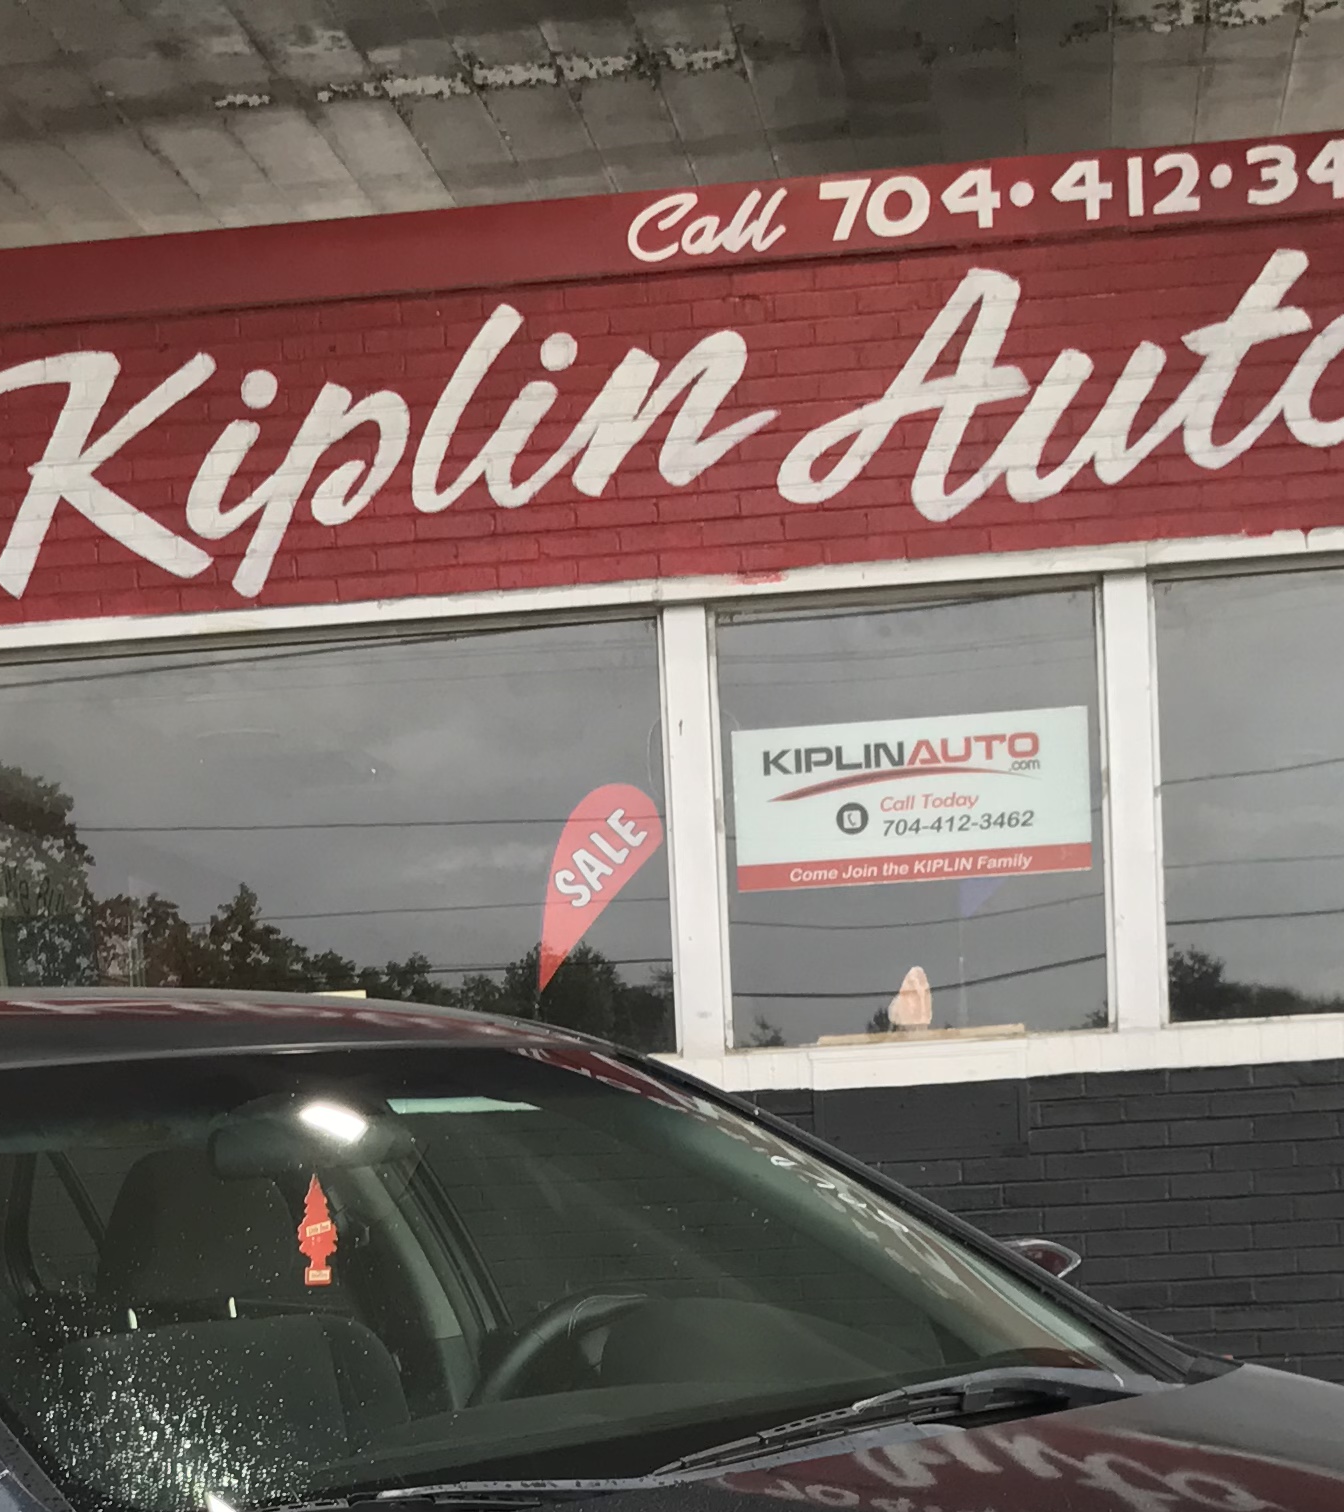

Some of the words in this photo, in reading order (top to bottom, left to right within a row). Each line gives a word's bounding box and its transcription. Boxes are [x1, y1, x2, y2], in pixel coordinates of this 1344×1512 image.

[627, 188, 786, 263] Call
[1009, 759, 1041, 772] .com
[880, 795, 915, 812] Call
[922, 792, 979, 810] Today
[883, 810, 1035, 837] 704-412-3462
[555, 808, 648, 907] SALE
[790, 867, 838, 882] Come
[842, 863, 878, 880] Join
[882, 862, 909, 877] the
[914, 857, 973, 874] KIPLIN
[977, 853, 1033, 871] Family
